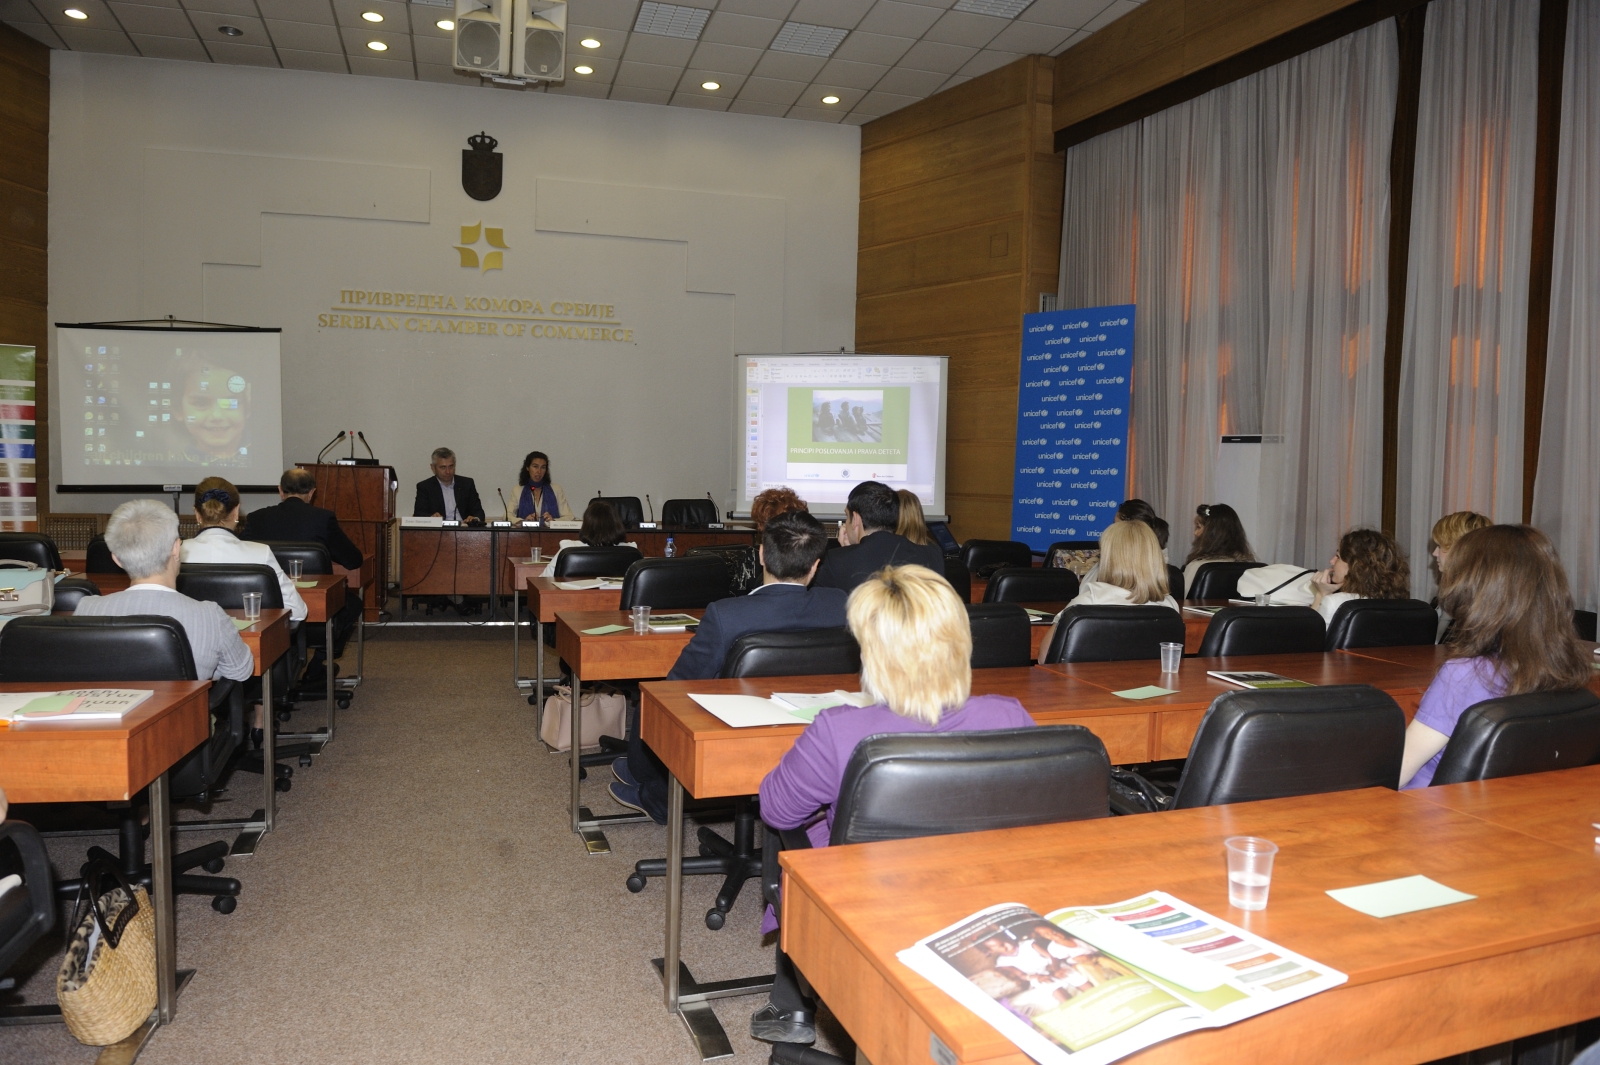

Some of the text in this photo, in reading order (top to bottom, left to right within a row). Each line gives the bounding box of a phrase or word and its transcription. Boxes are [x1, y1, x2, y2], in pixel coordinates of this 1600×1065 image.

[340, 289, 615, 319] ПРИВРЕДНА КОМОРА СРБИЈЕ
[317, 313, 634, 343] SERBIAN CHAMBER OF COMMERCE
